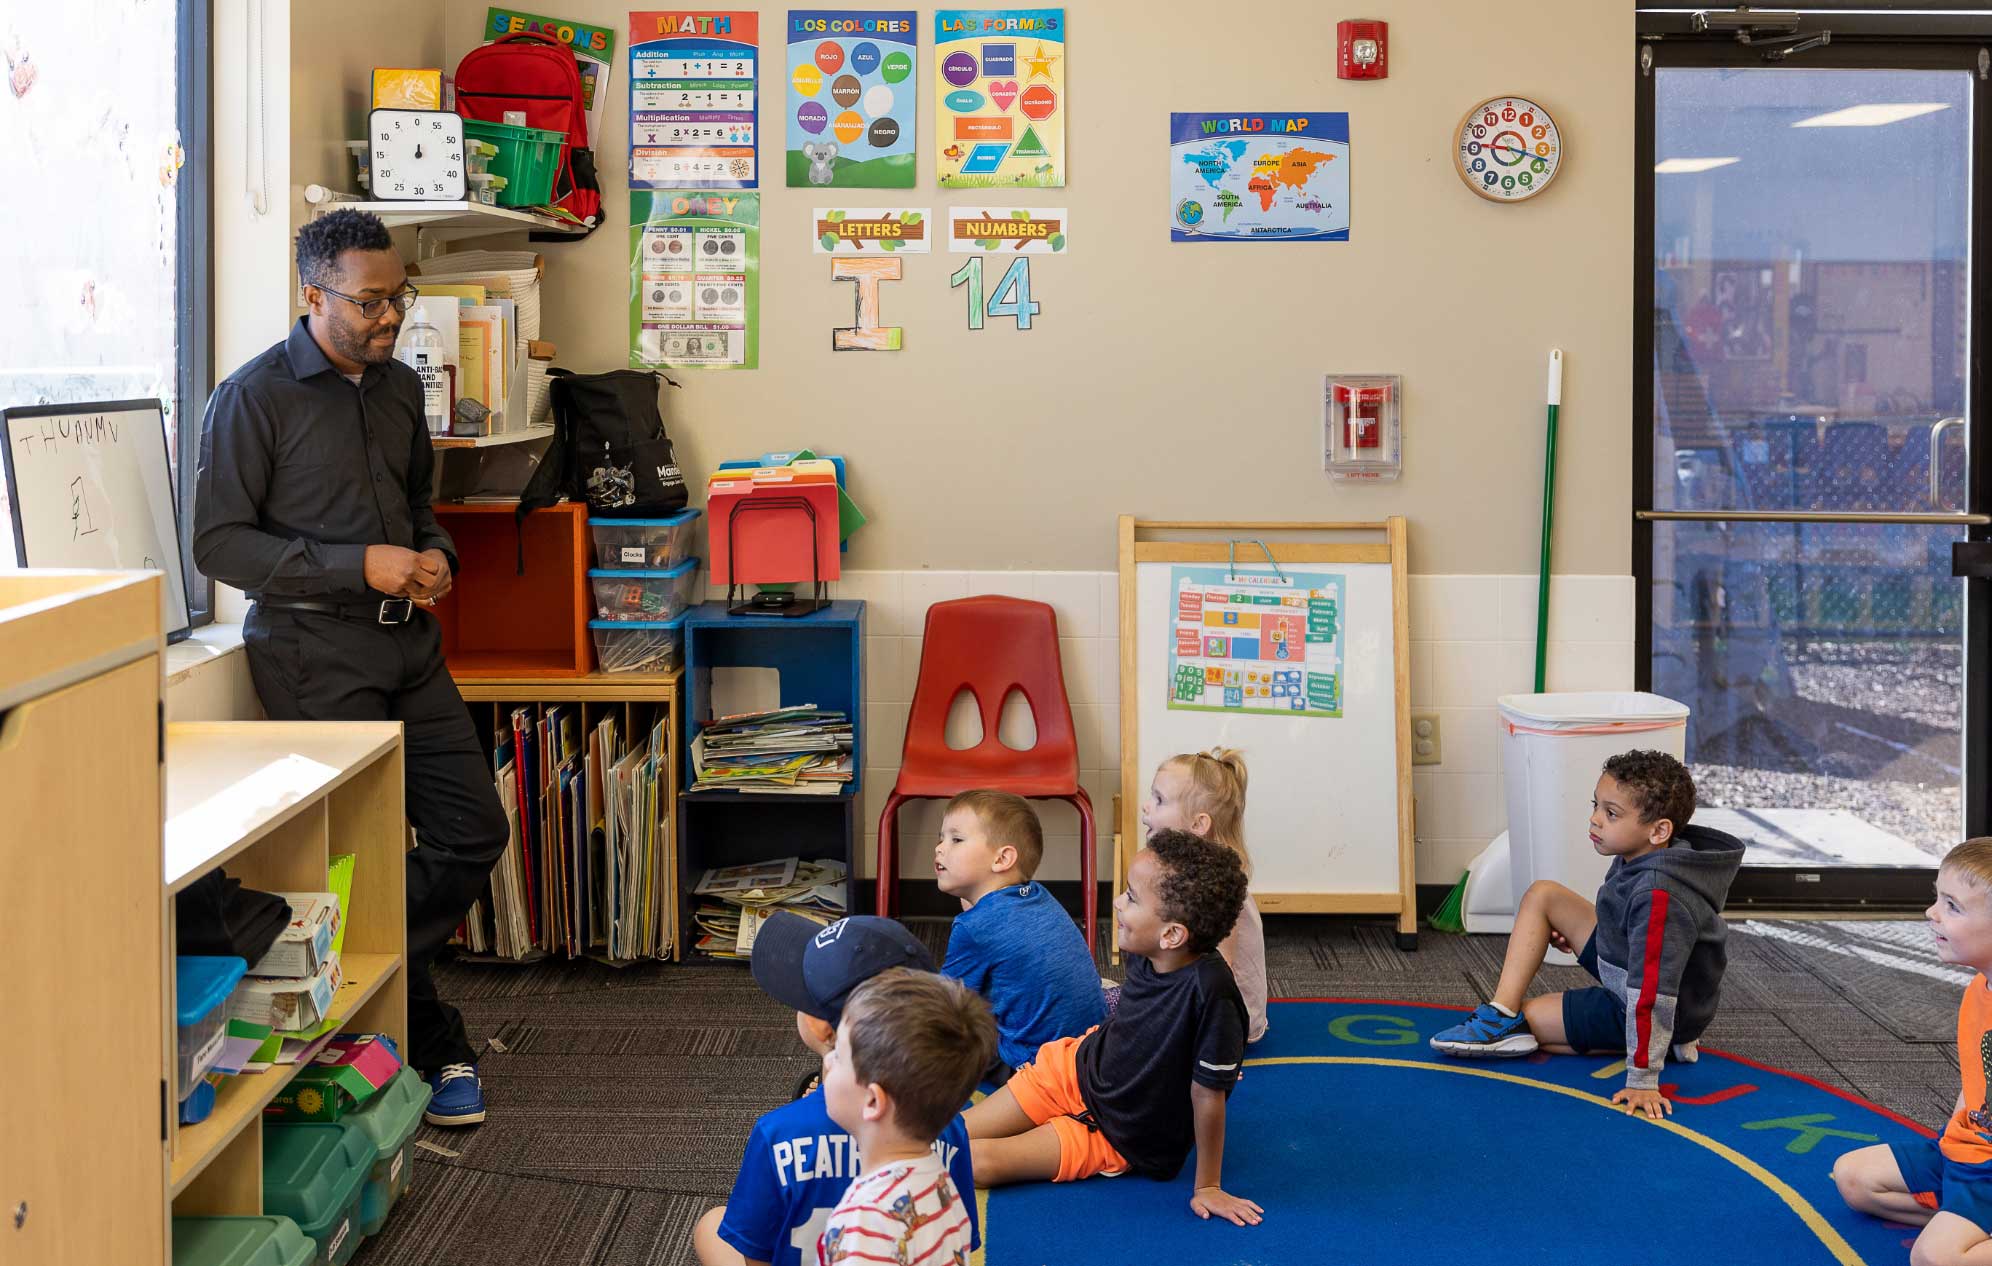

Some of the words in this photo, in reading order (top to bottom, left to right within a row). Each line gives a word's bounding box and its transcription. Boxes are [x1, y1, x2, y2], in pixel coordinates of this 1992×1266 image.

[656, 16, 731, 34] MATH
[795, 19, 826, 32] LOS
[830, 20, 910, 32] COLORES
[942, 19, 976, 32] LAS
[984, 18, 1057, 31] FORMAS
[494, 14, 607, 50] SEASONS
[1487, 115, 1496, 124] 11
[1503, 110, 1515, 120] 12
[1524, 116, 1528, 124] 1
[1201, 118, 1264, 133] WORLD
[1271, 118, 1309, 132] MAP
[1473, 128, 1485, 136] 10
[1536, 128, 1542, 137] 2
[1471, 144, 1478, 153] 9
[1540, 145, 1546, 154] 3
[1476, 161, 1482, 169] 8
[1488, 174, 1494, 182] 7
[1505, 179, 1511, 187] 6
[1522, 174, 1528, 183] 5
[654, 197, 740, 216] MONEY
[839, 223, 902, 236] LETTERS
[966, 222, 1047, 236] NUMBERS
[951, 256, 1040, 330] 14
[1328, 1014, 1419, 1046] G
[1741, 1113, 1880, 1154] K
